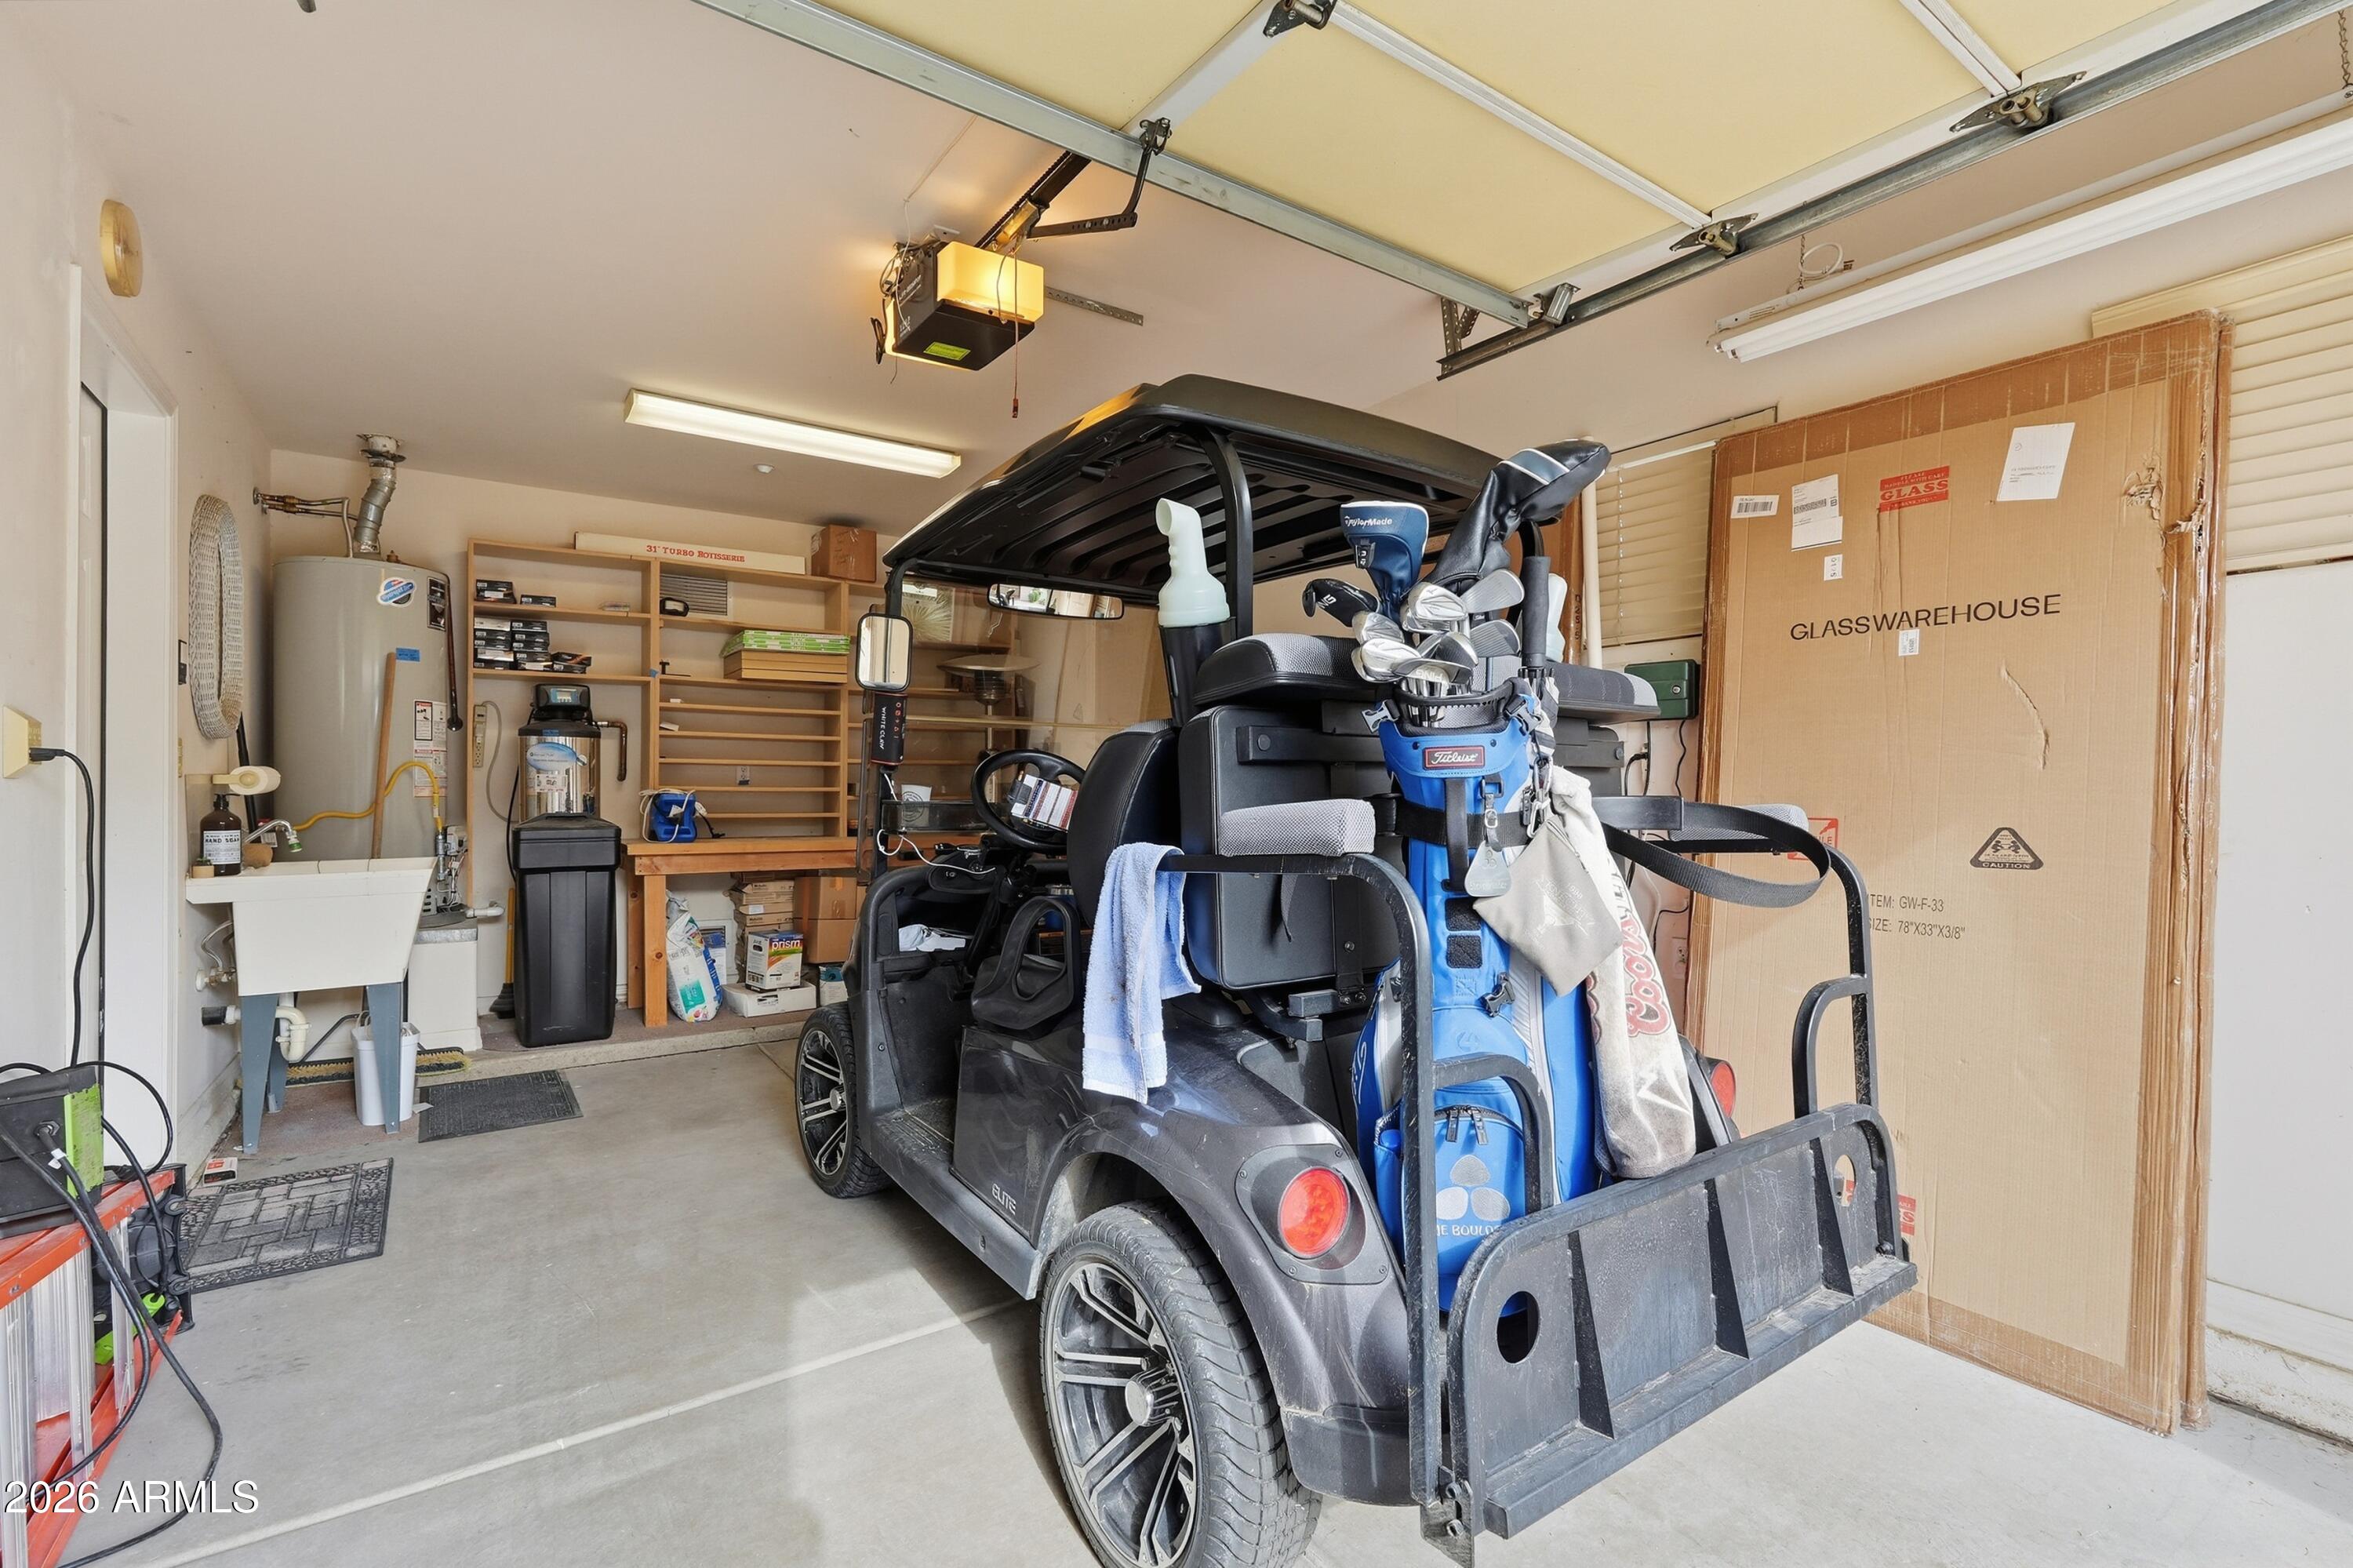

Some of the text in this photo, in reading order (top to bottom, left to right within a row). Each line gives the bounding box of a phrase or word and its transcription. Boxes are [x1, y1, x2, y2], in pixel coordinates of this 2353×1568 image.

[1880, 479, 1948, 501] GLASS
[1344, 515, 1393, 529] TaylorMade
[662, 546, 695, 558] TURBO
[696, 550, 745, 562] ROTISSERIE
[1790, 594, 2061, 641] GLASSWAREHOUSE
[1899, 895, 1944, 912] GW-F-33
[772, 939, 801, 951] prism
